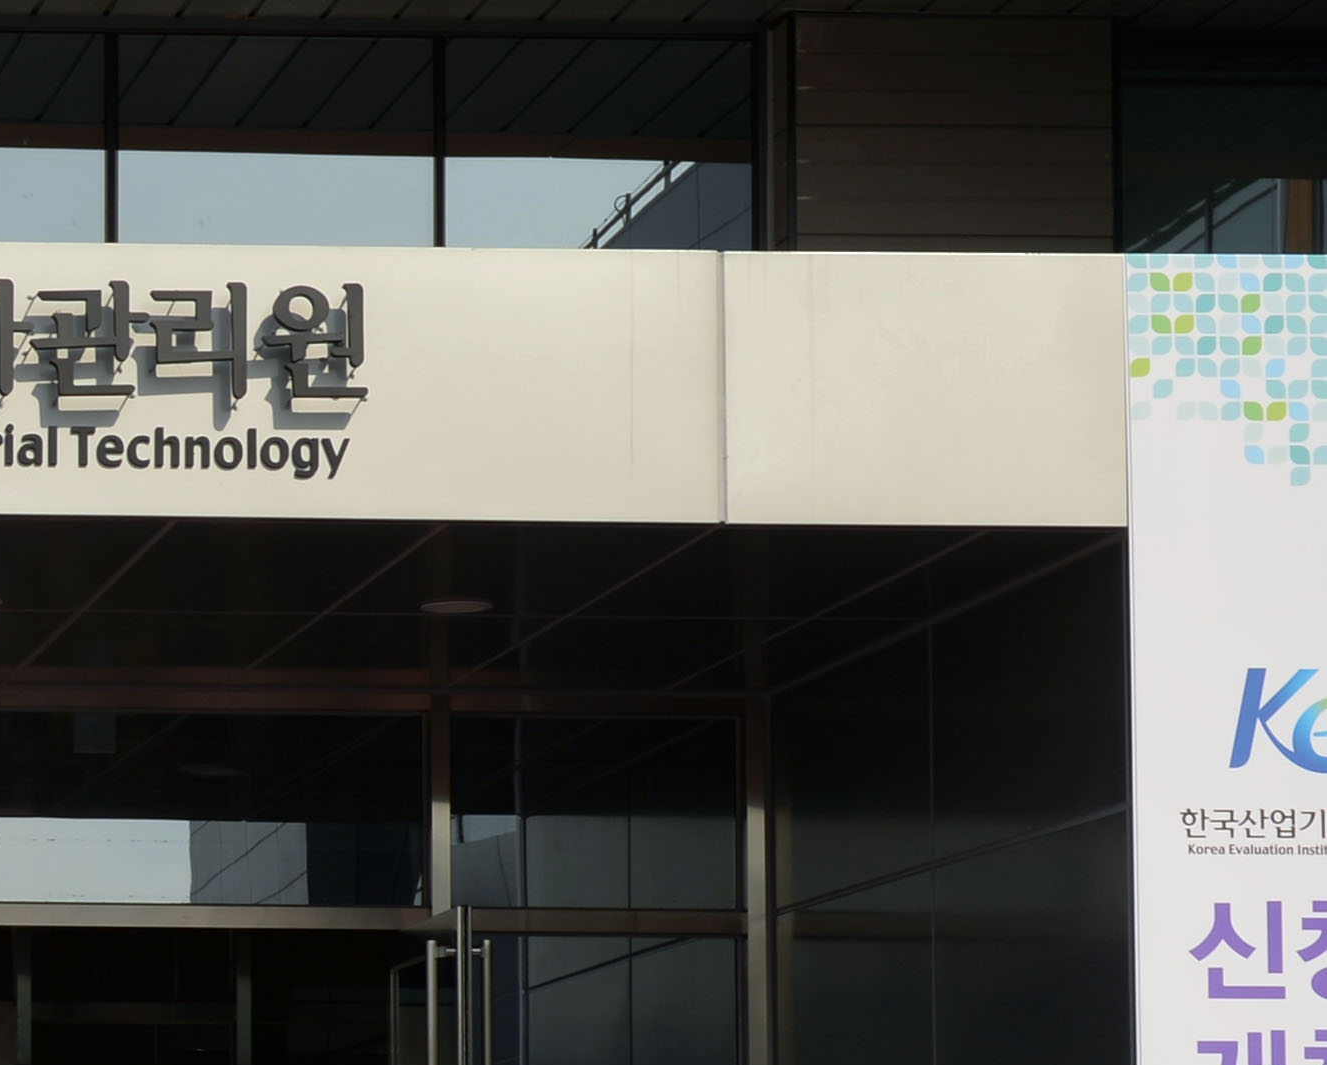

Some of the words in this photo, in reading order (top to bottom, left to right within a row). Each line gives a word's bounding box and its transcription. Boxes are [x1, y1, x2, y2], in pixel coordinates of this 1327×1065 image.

[70, 426, 351, 479] Technology
[1188, 843, 1226, 856] Korea
[1229, 843, 1295, 856] Evaluation
